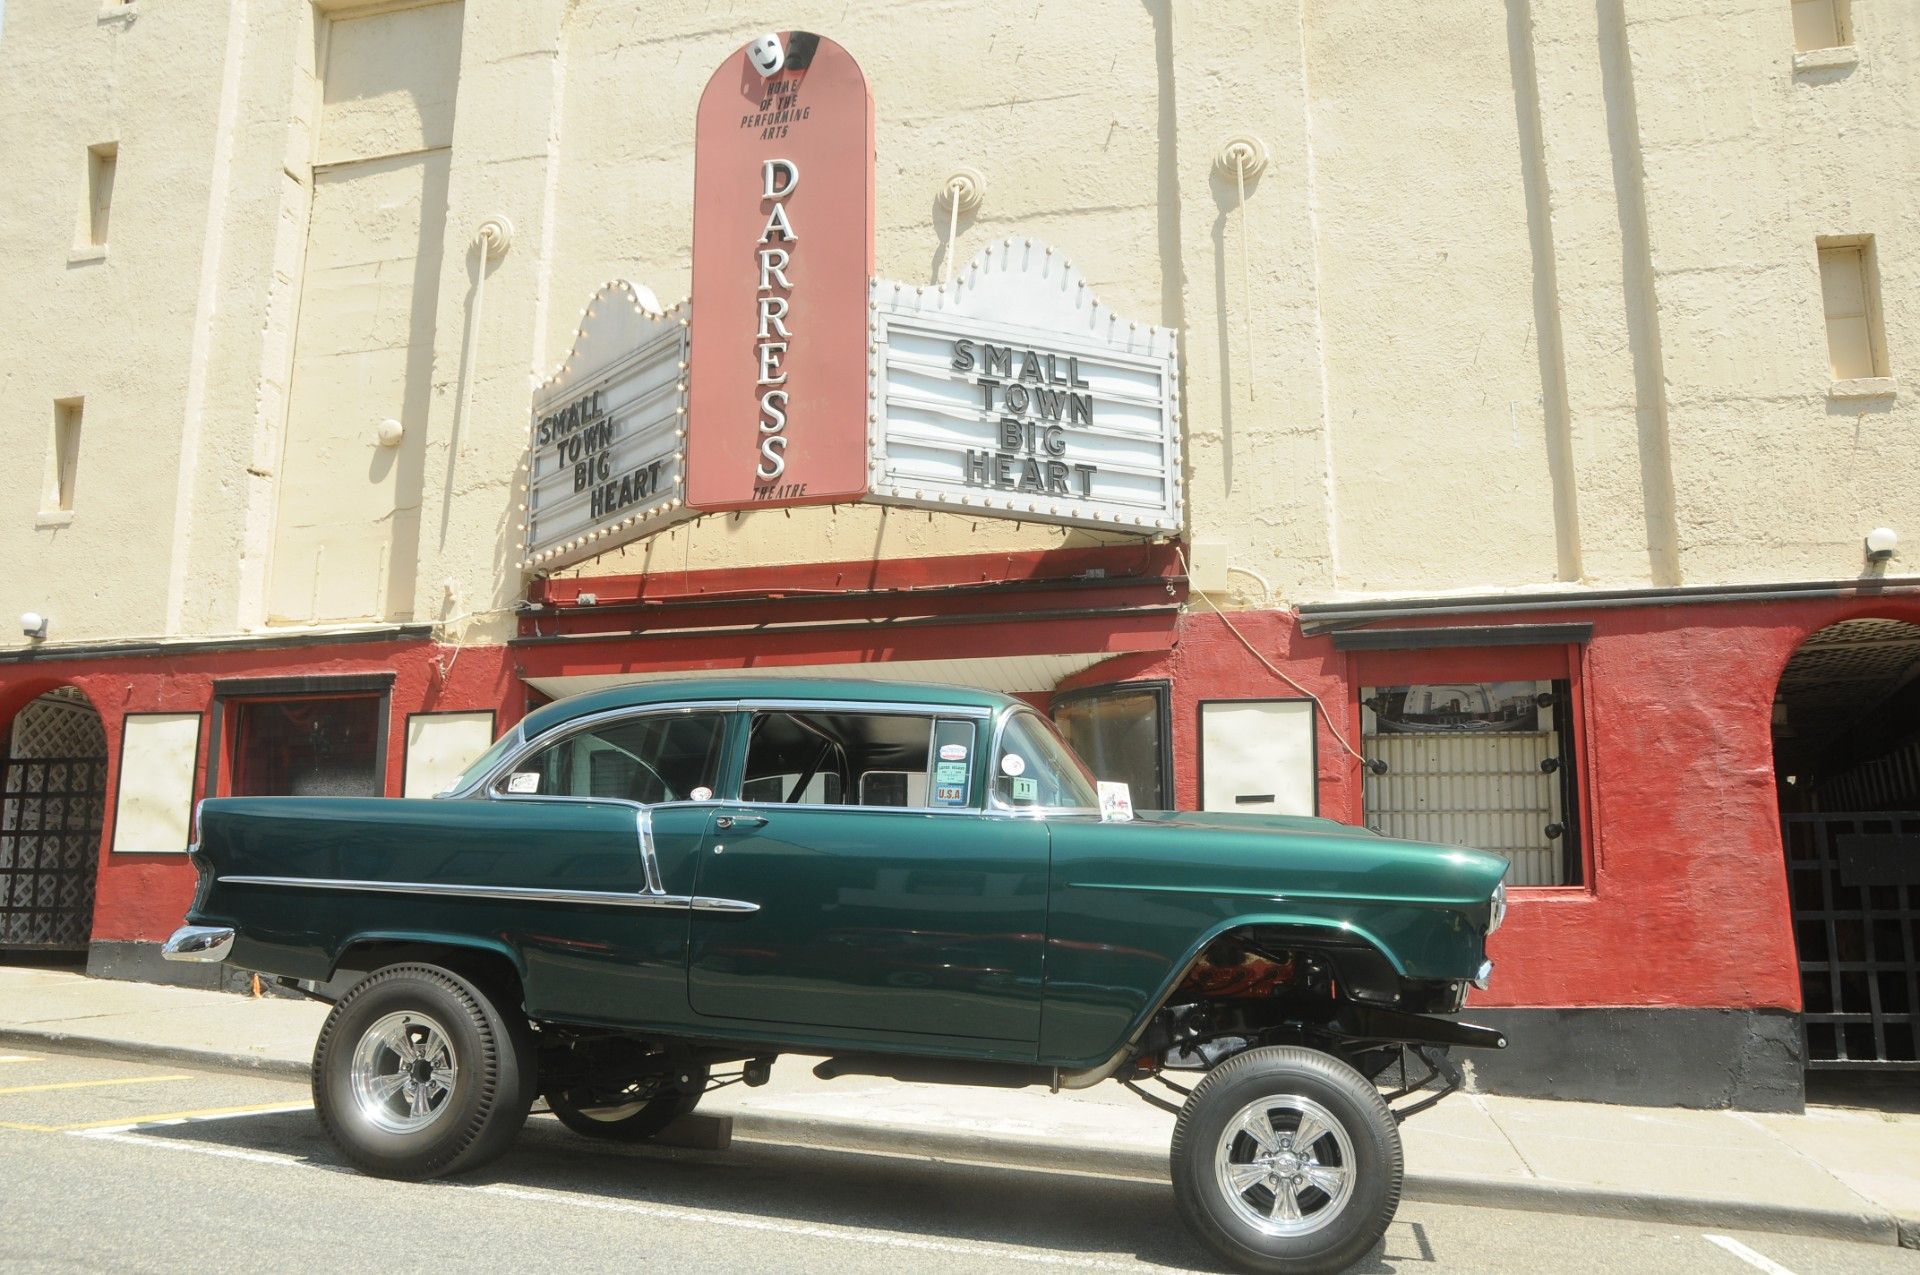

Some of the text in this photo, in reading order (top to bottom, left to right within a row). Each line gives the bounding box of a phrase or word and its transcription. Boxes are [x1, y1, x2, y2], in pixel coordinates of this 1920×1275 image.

[760, 95, 797, 111] OF THE
[767, 80, 797, 95] HOME
[741, 107, 810, 127] PERFORMING
[760, 125, 788, 140] ARTS
[757, 158, 799, 479] DARRESS
[952, 339, 1089, 388] SMALL
[540, 390, 603, 445] SMALL
[977, 378, 1094, 426] TOWN
[557, 416, 613, 469] TOWN
[1000, 417, 1066, 457] BIG
[574, 450, 610, 493] BIG
[591, 460, 661, 519] HEART
[752, 483, 808, 501] THEATRE
[966, 448, 1097, 497] HEART
